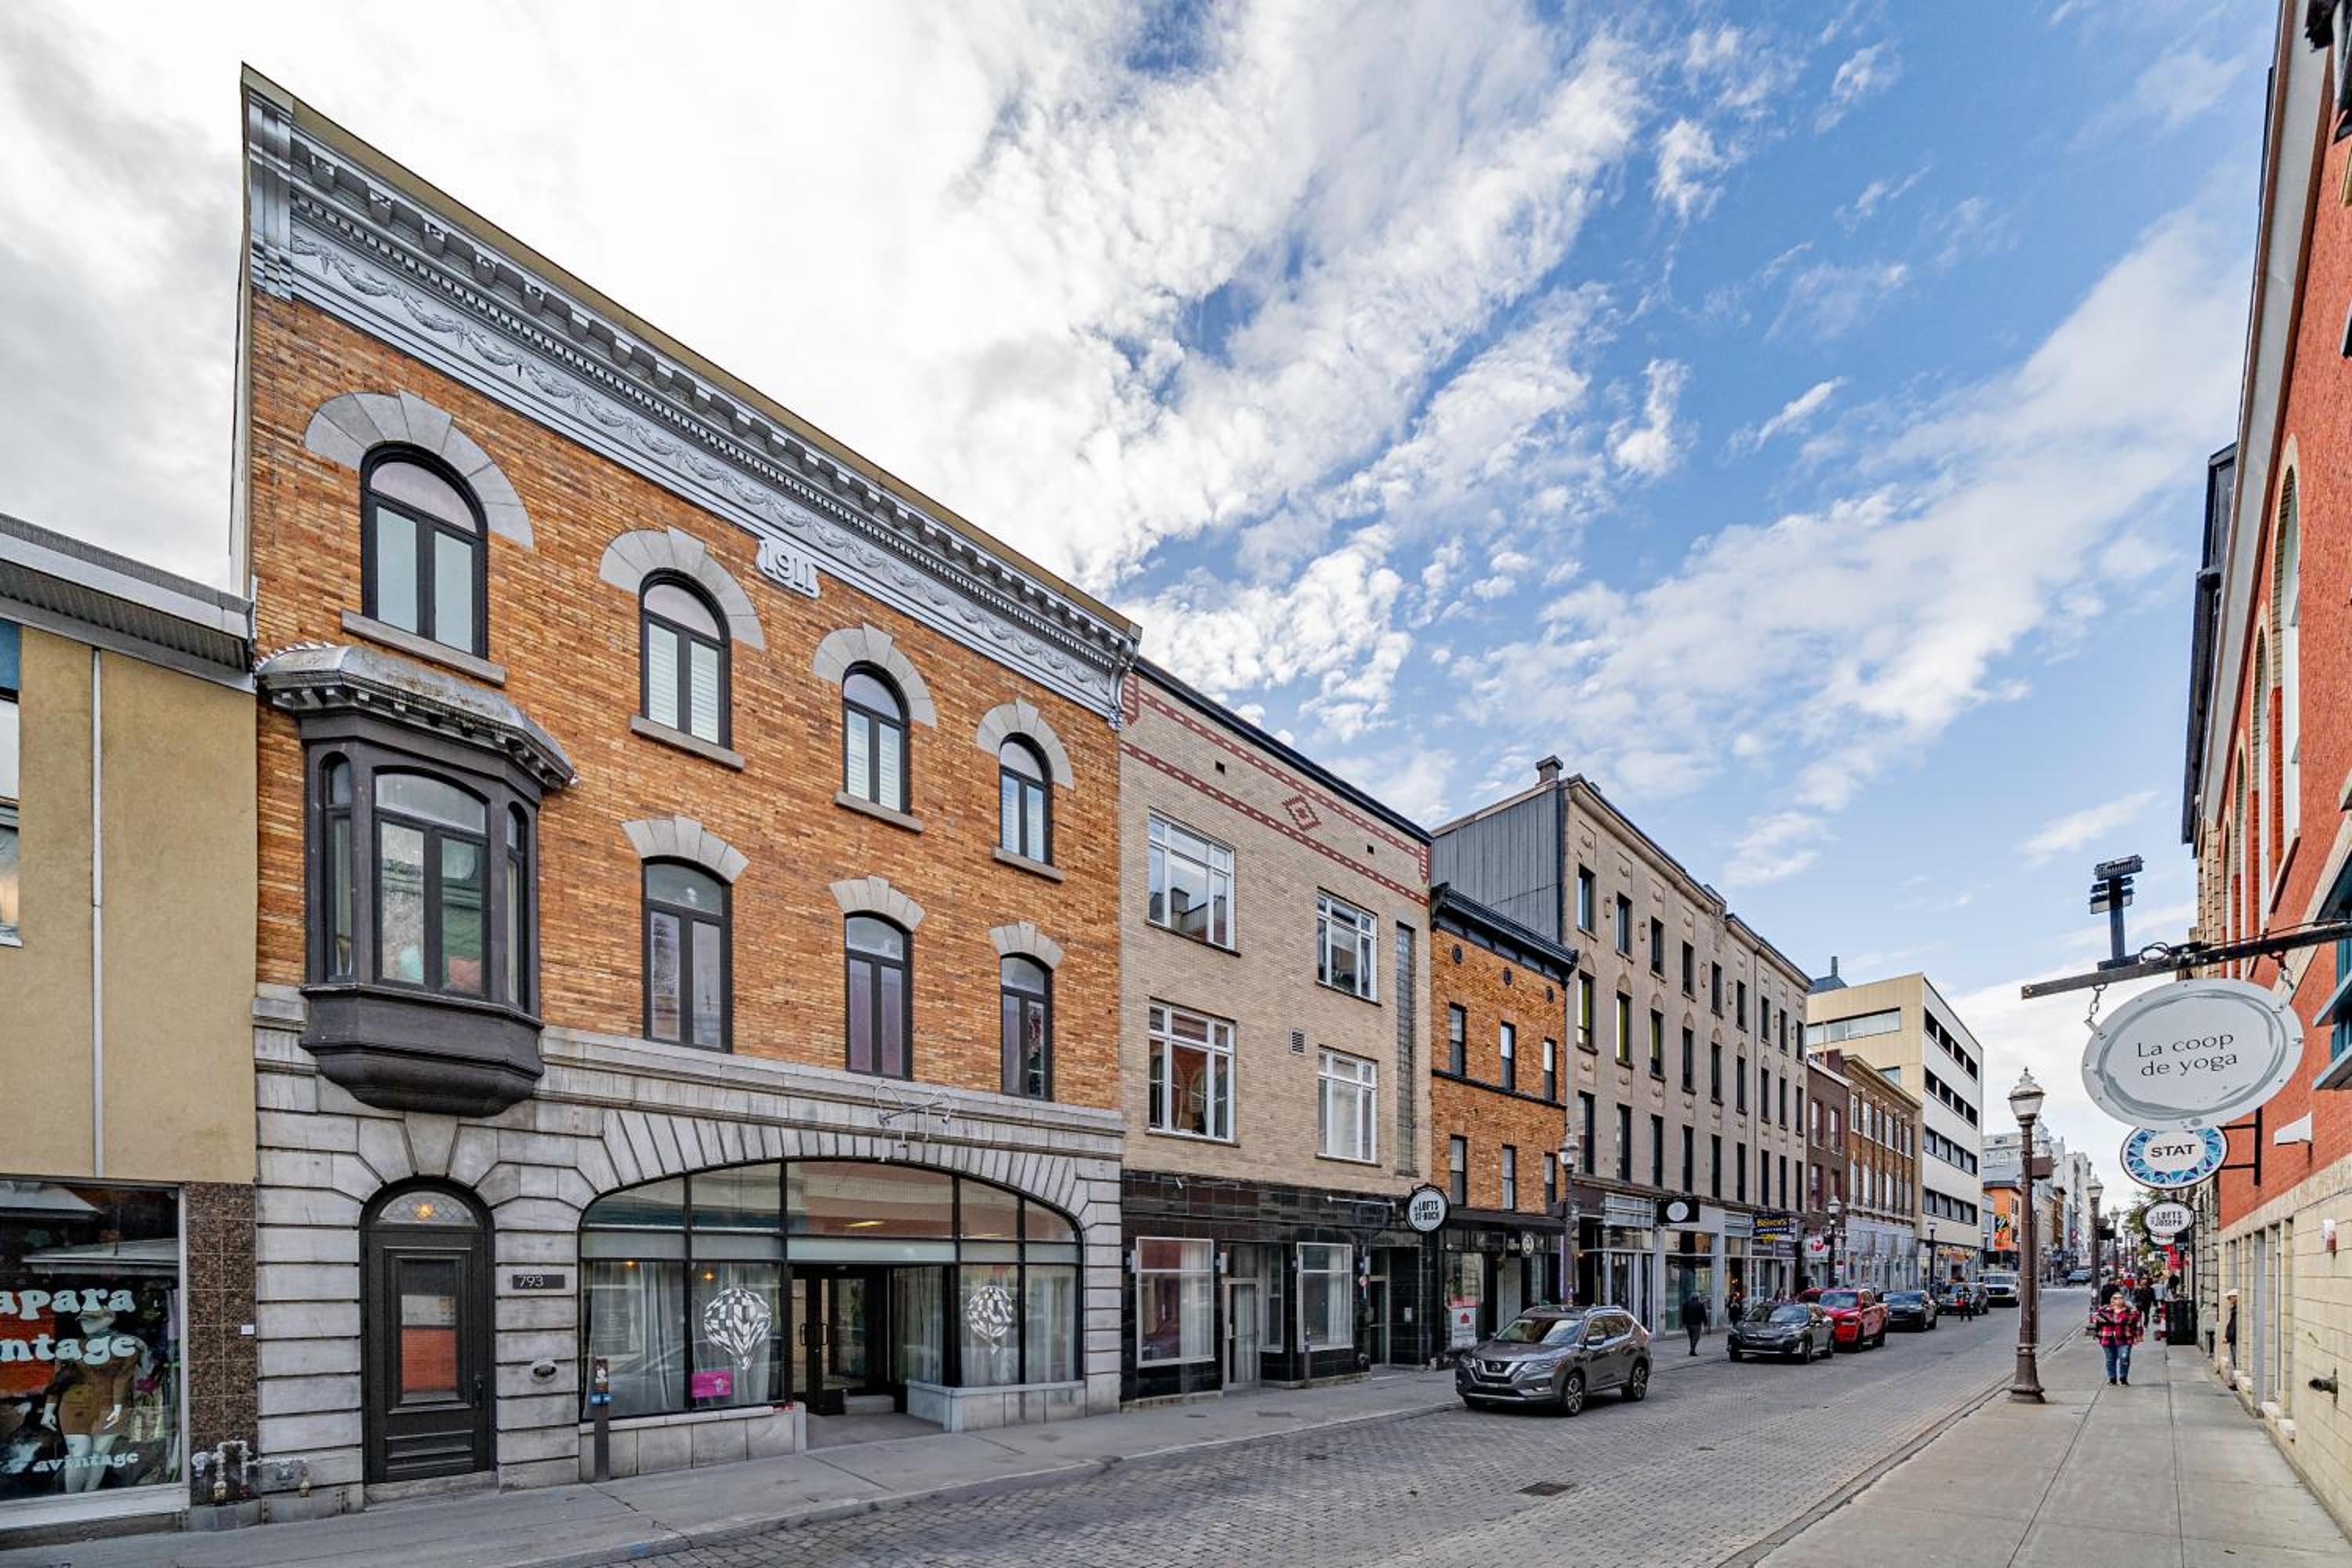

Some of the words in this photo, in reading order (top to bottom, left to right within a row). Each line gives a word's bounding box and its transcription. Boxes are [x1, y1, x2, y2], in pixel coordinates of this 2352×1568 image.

[762, 541, 815, 593] 1911
[2137, 1042, 2162, 1058] La
[2172, 1034, 2234, 1052] coop
[2141, 1061, 2170, 1076] de
[2180, 1054, 2237, 1076] yoga
[2151, 1144, 2196, 1158] STAT
[1418, 1200, 1439, 1211] LOFTS
[2156, 1210, 2183, 1219] LOFTS
[518, 1276, 543, 1287] 793
